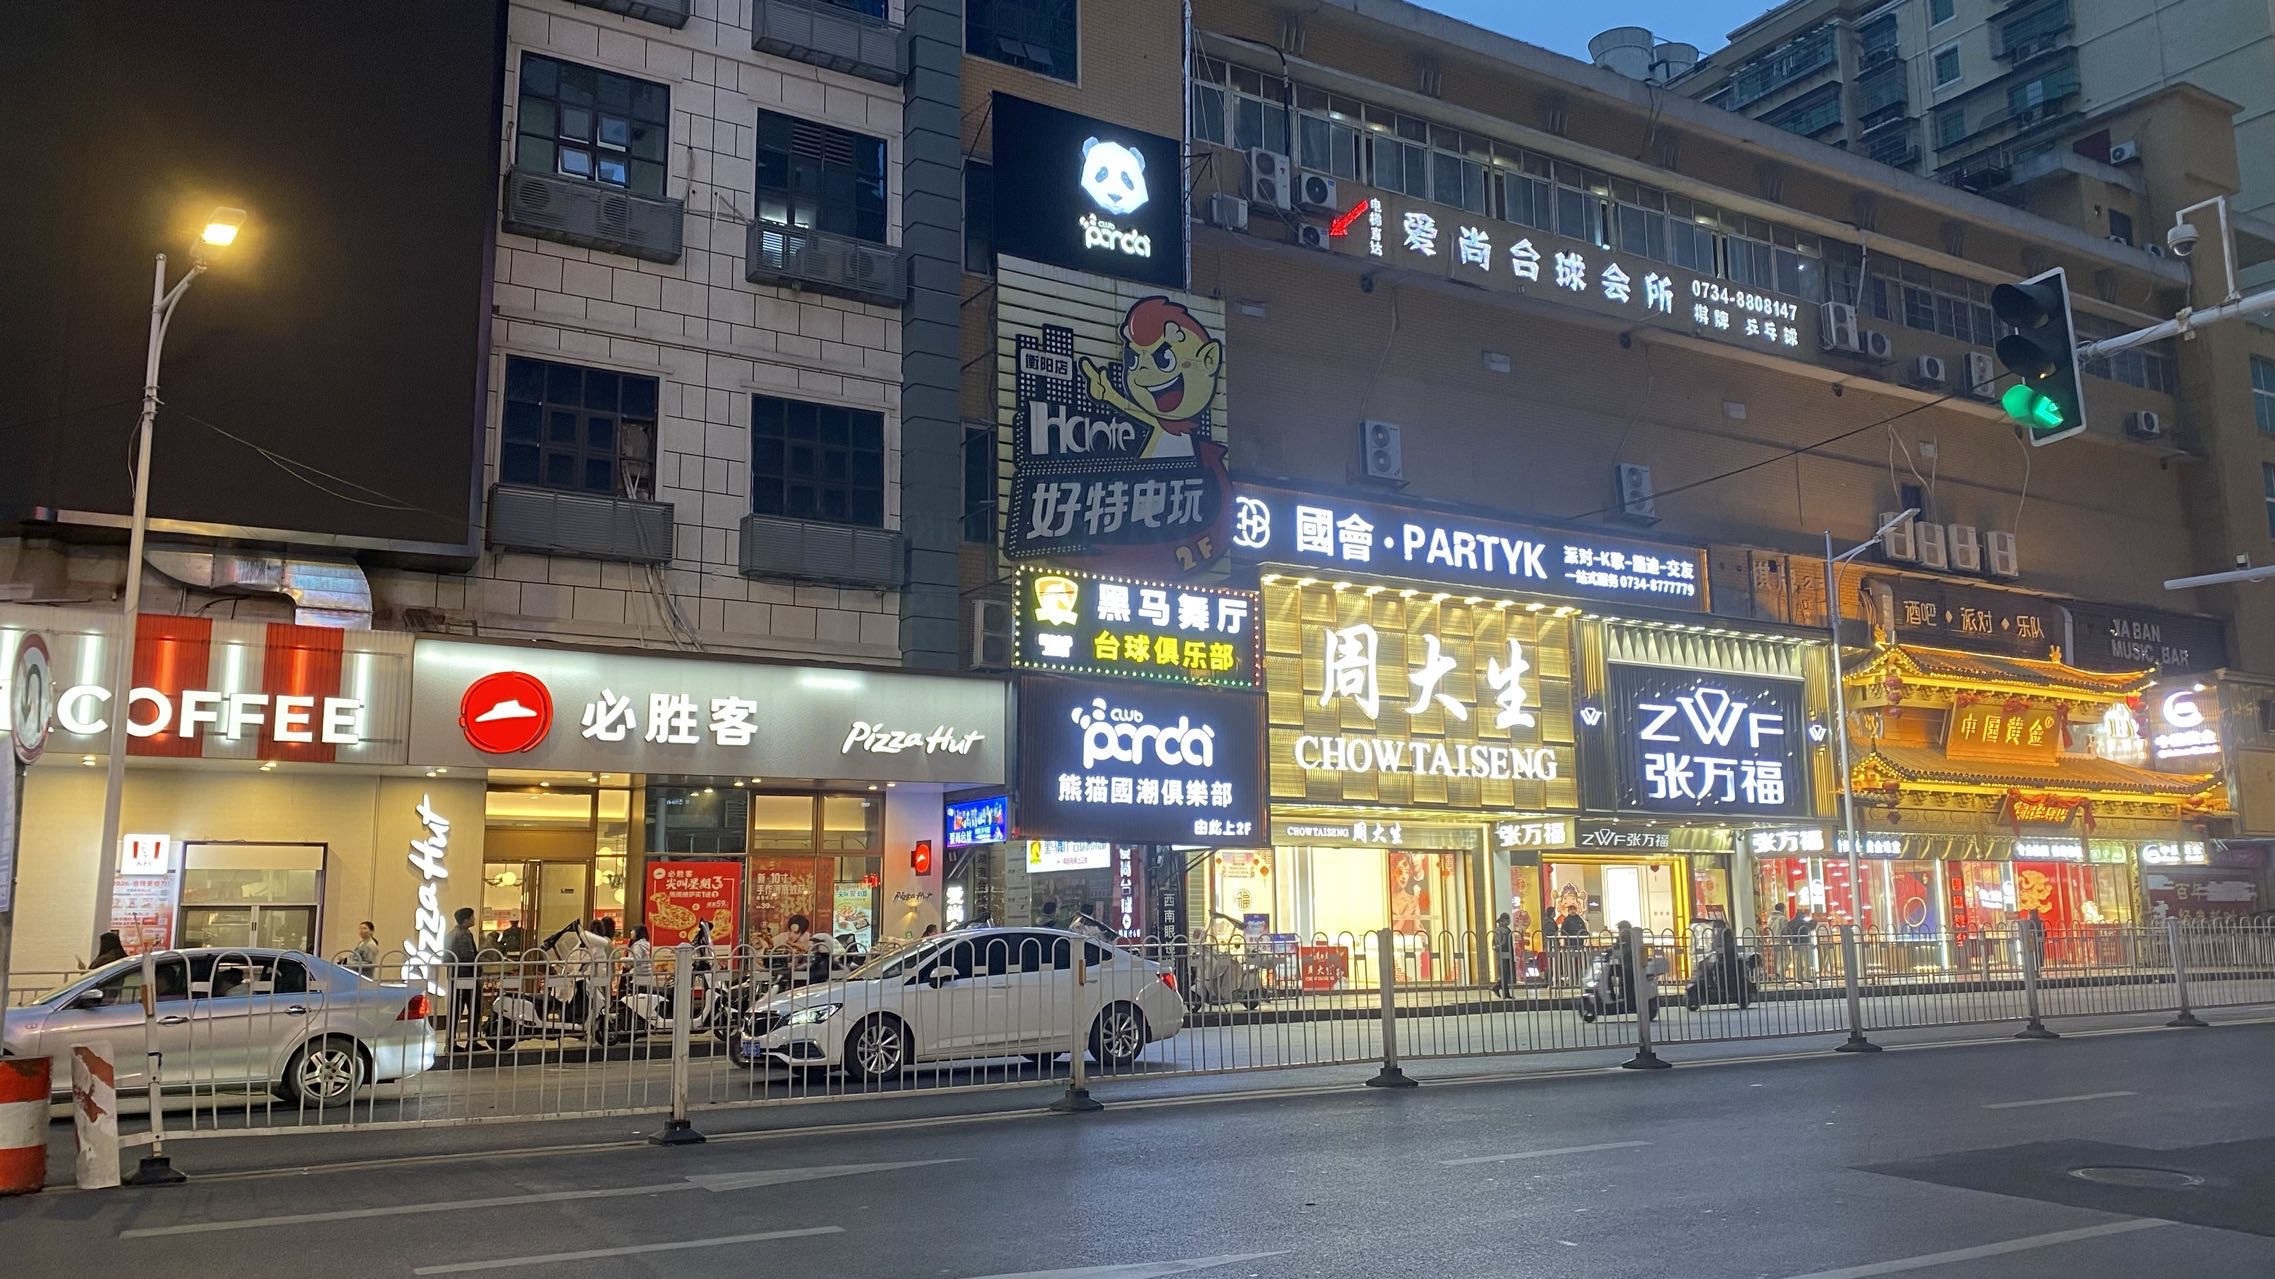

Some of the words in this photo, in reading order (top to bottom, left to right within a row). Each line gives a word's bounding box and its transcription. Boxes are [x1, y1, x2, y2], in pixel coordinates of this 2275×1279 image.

[1402, 211, 1674, 315] 爱尚台球会所
[1692, 279, 1798, 321] 0734-8808147
[1025, 353, 1069, 376] 衡阳店
[1026, 477, 1204, 540] 好特电玩
[1175, 535, 1214, 573] 2F
[1295, 504, 1374, 562] 國會
[1402, 523, 1548, 581] PARTYK
[1097, 583, 1248, 634] 黑马舞厅
[1903, 601, 1937, 627] 酒吧
[1960, 607, 1993, 633] 派对
[2016, 615, 2045, 639] 乐队
[1094, 630, 1234, 671] 台球俱乐部
[2132, 621, 2161, 642] BAN
[2111, 638, 2154, 662] MUSIC
[2161, 645, 2190, 669] BAR
[1318, 624, 1538, 729] 周大生
[57, 685, 359, 745] COFFEE
[580, 688, 759, 747] 必胜客
[1638, 687, 1784, 747] ZWF
[841, 721, 924, 755] Pizza
[923, 725, 984, 755] Hut
[1058, 773, 1233, 808] 熊猫國潮俱樂部
[1644, 751, 1784, 806] 张万福
[408, 792, 450, 880] Hut
[1194, 819, 1252, 836] 由此上2F
[1352, 821, 1403, 844] 周大生
[1498, 822, 1566, 847] 张万福
[1753, 830, 1824, 853] 张万福
[400, 882, 447, 997] Pizza
